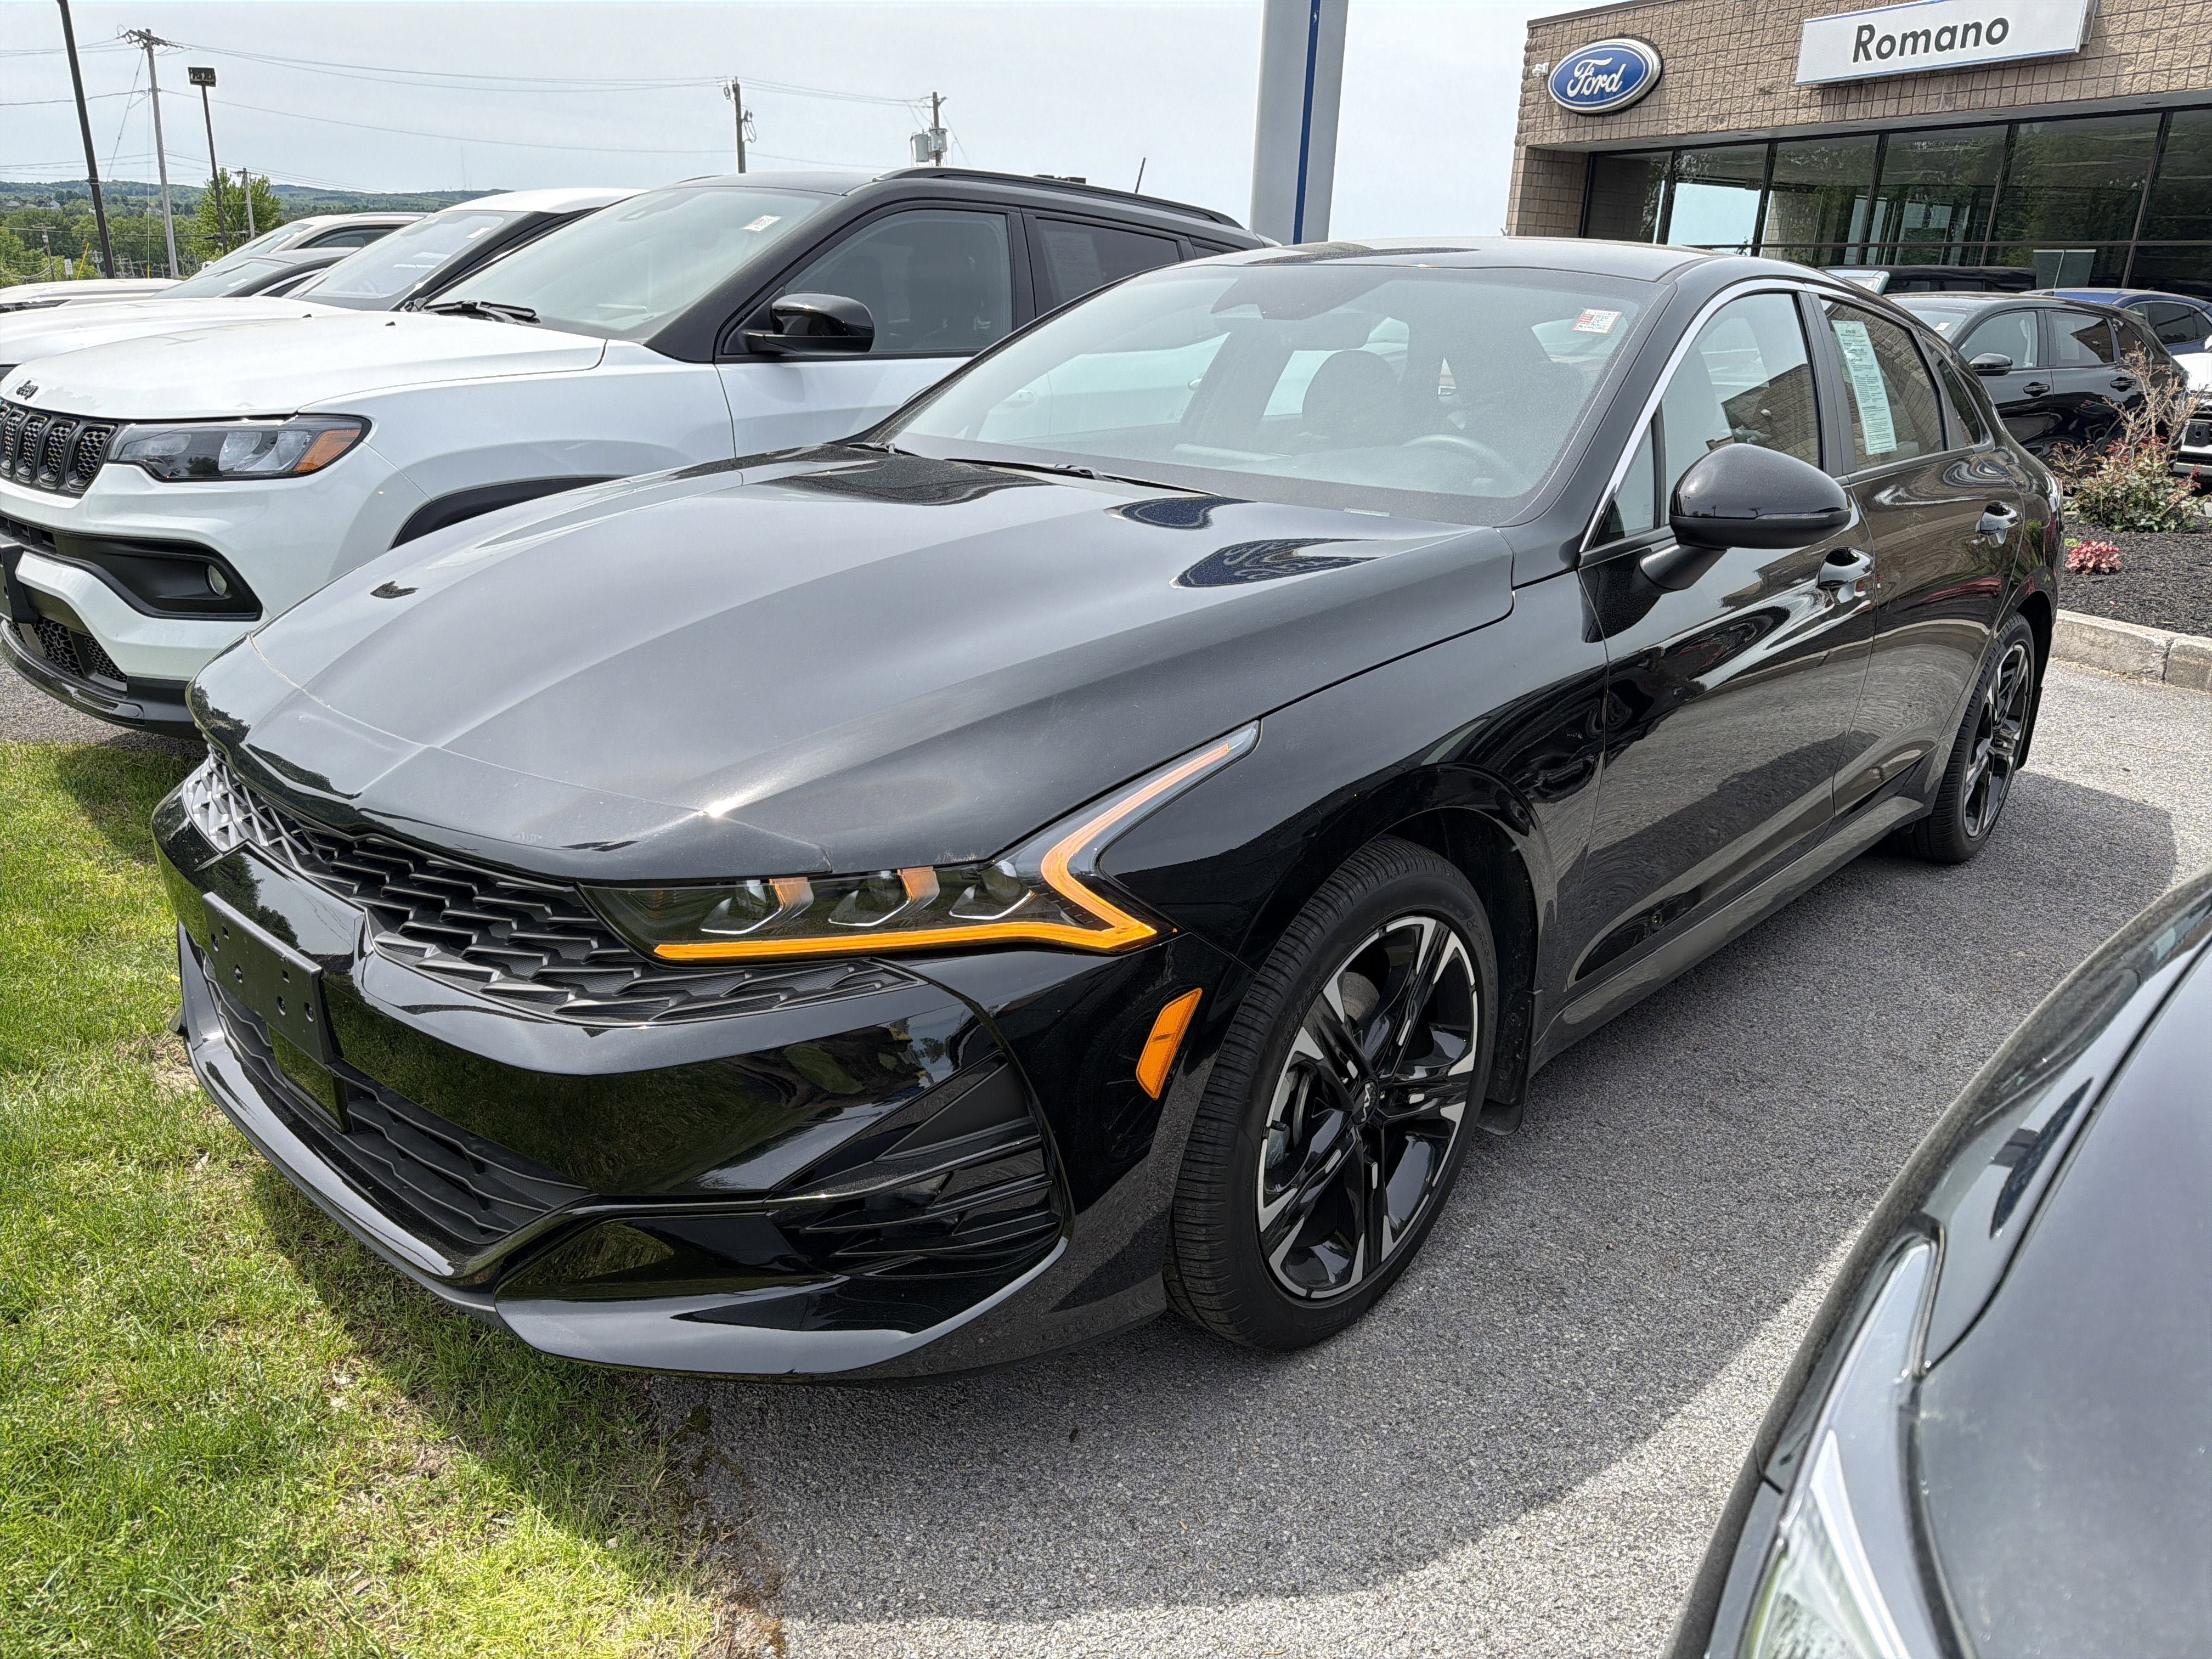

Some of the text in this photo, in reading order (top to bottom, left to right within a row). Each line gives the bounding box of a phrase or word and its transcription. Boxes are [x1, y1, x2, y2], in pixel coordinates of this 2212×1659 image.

[1852, 18, 2009, 63] Romano
[1567, 57, 1627, 97] Ford
[16, 380, 39, 400] Jeep
